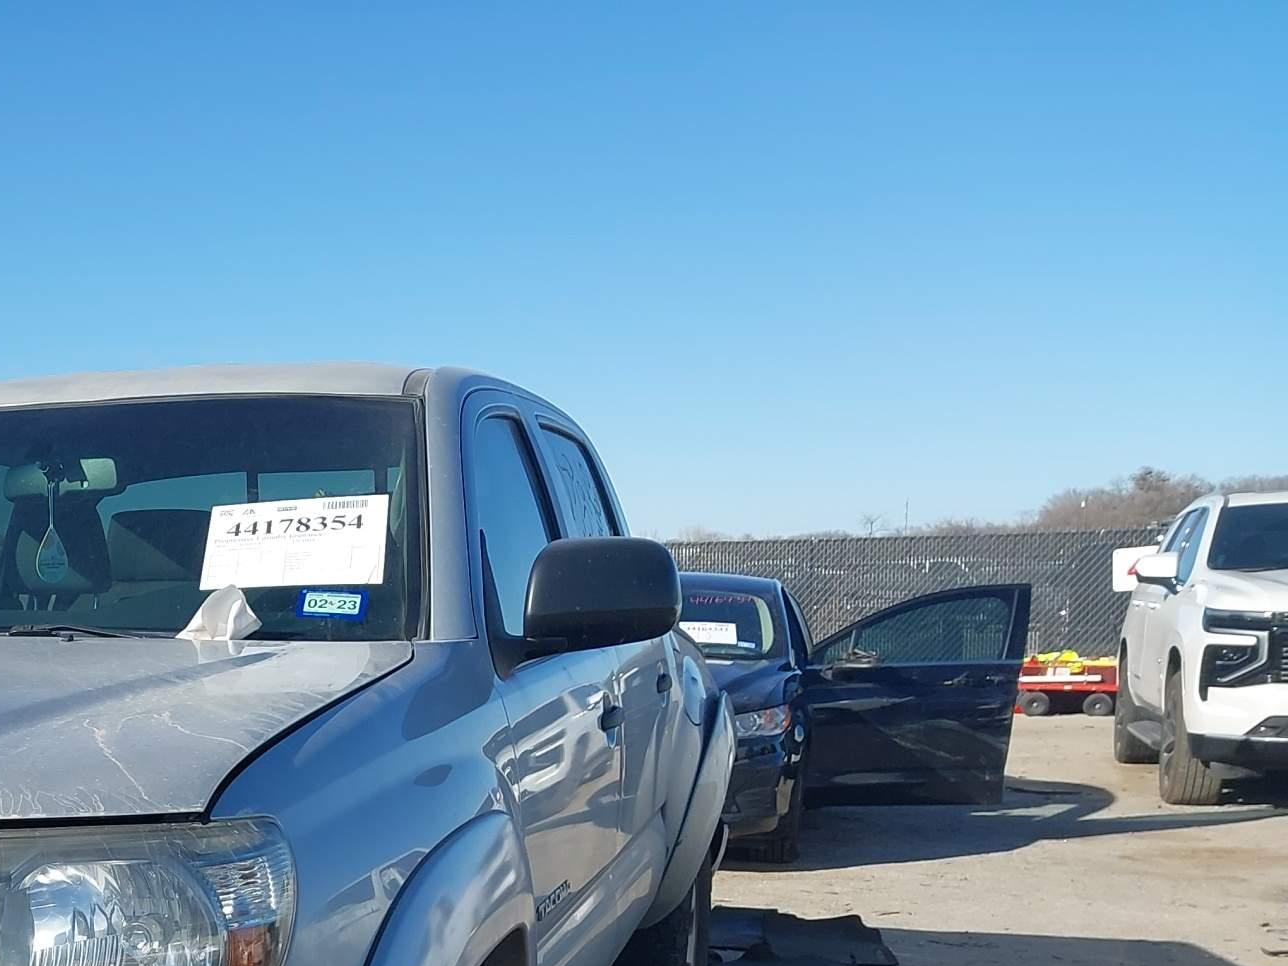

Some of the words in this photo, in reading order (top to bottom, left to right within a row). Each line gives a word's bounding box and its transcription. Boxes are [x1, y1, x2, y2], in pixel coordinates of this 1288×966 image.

[226, 513, 364, 537] 44178354
[307, 598, 329, 609] 02
[336, 599, 358, 611] 23
